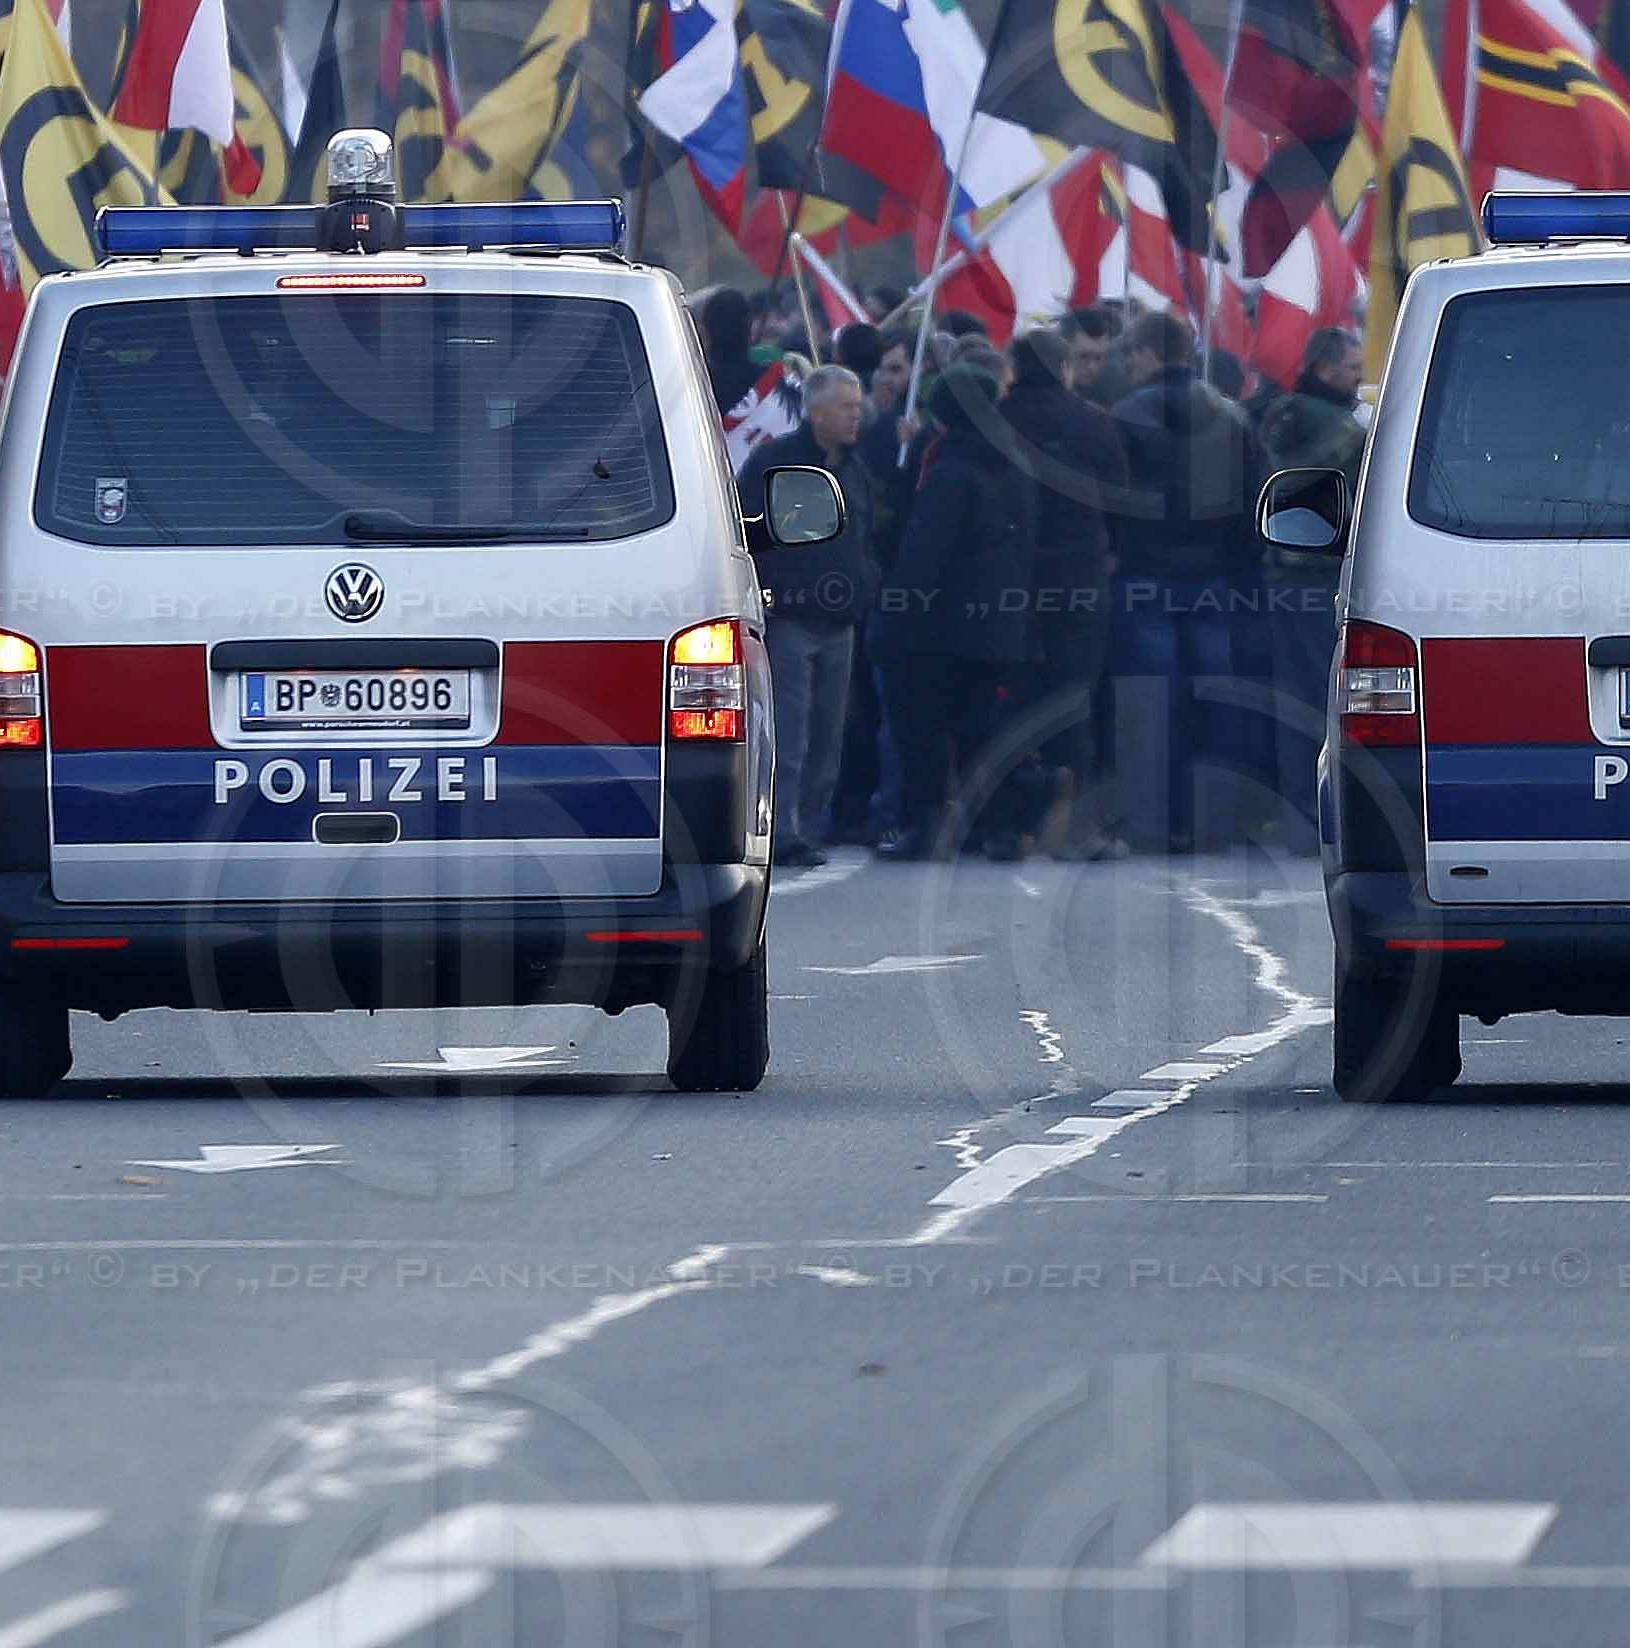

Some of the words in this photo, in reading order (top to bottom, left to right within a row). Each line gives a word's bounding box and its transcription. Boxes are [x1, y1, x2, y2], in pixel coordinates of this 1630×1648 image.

[276, 679, 316, 712] BP
[345, 678, 452, 712] 60896
[214, 756, 498, 804] POLIZEI
